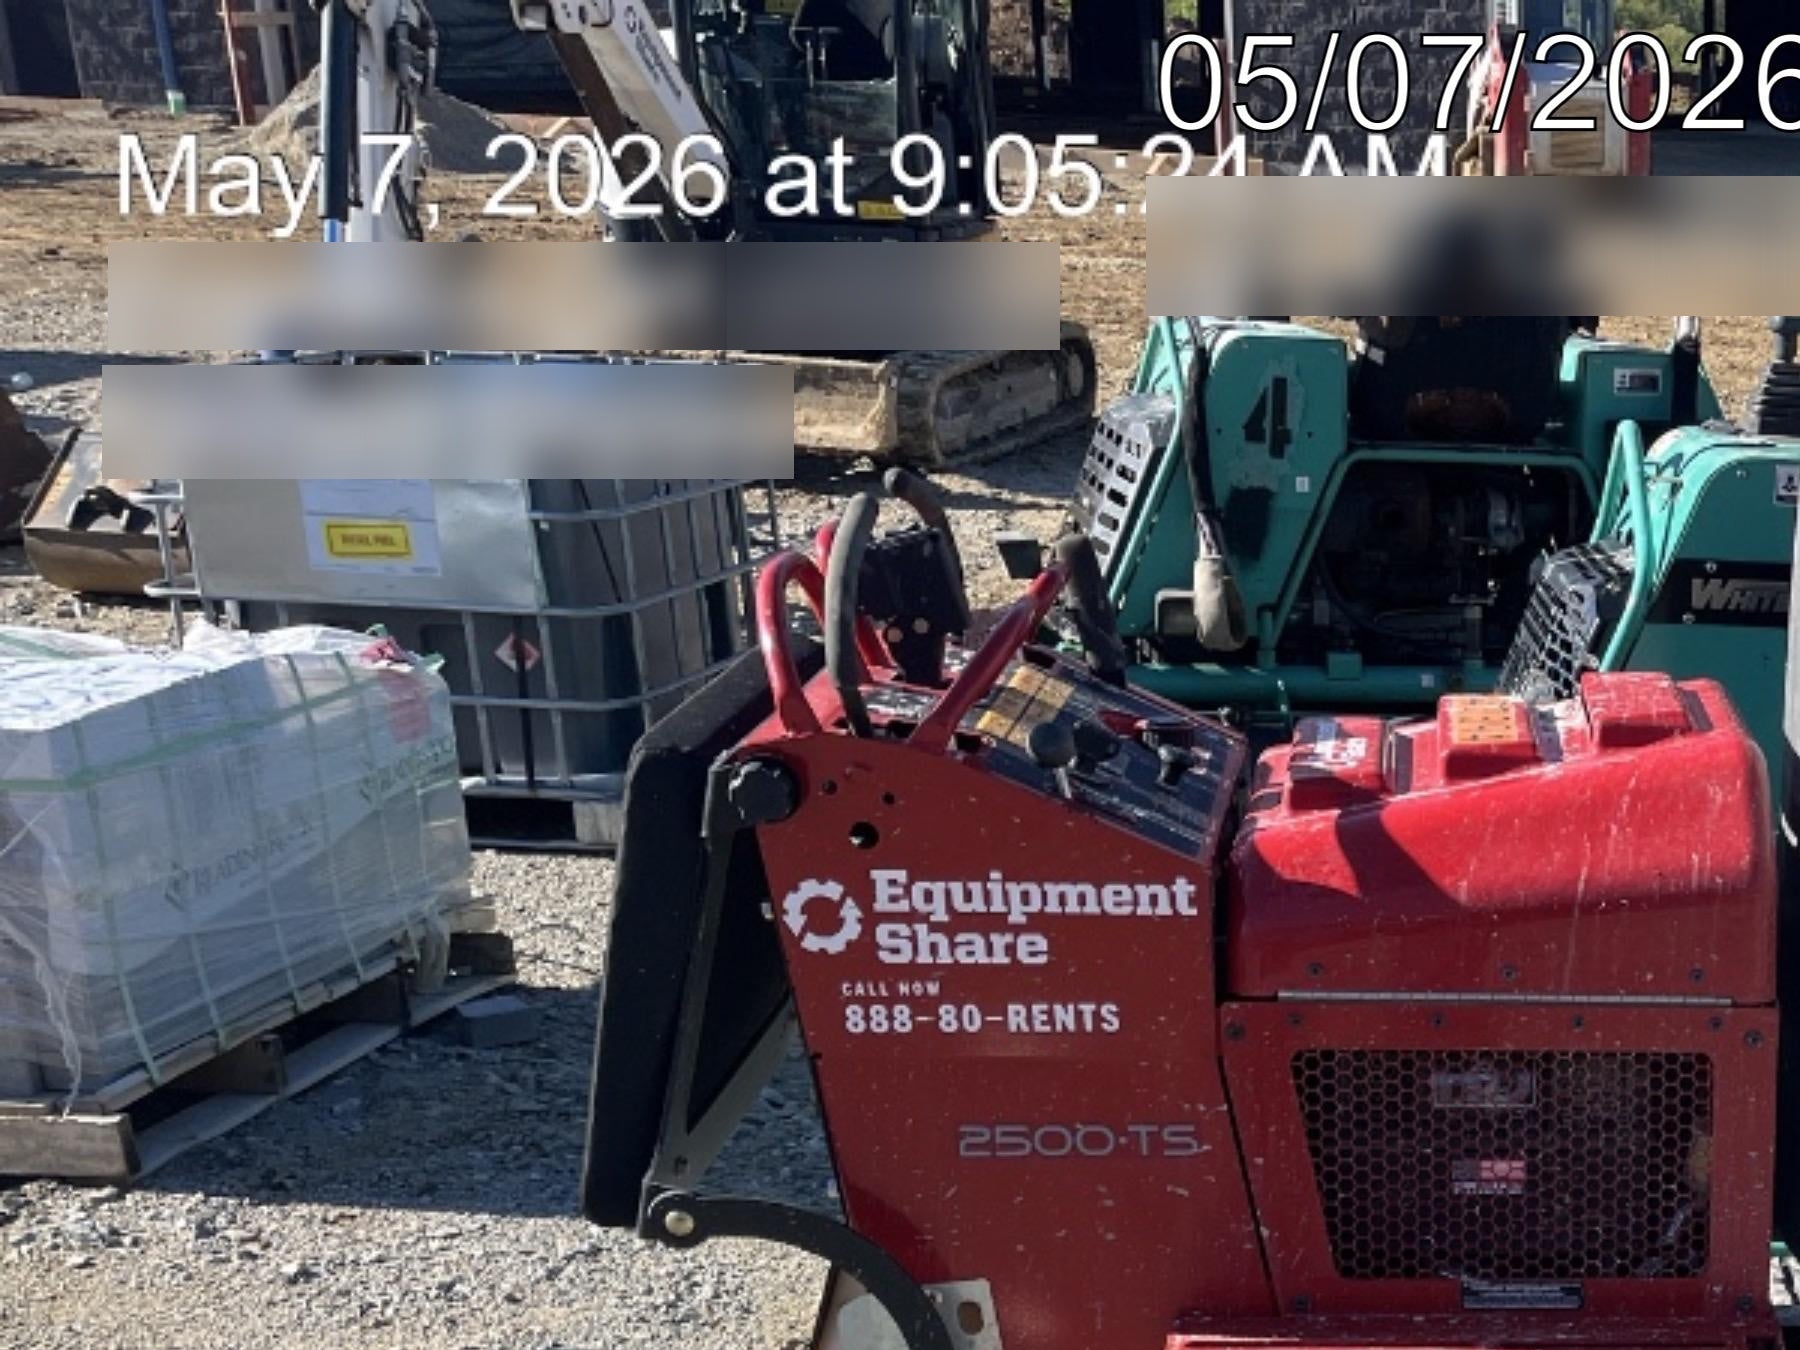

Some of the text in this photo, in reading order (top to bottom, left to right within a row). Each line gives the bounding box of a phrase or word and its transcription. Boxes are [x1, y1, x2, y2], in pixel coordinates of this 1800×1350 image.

[1241, 375, 1293, 461] 4
[869, 868, 1198, 924] Equipment
[875, 923, 1049, 964] Share
[841, 981, 941, 997] CALL NOW
[843, 1003, 1122, 1034] 888-80-RENTS
